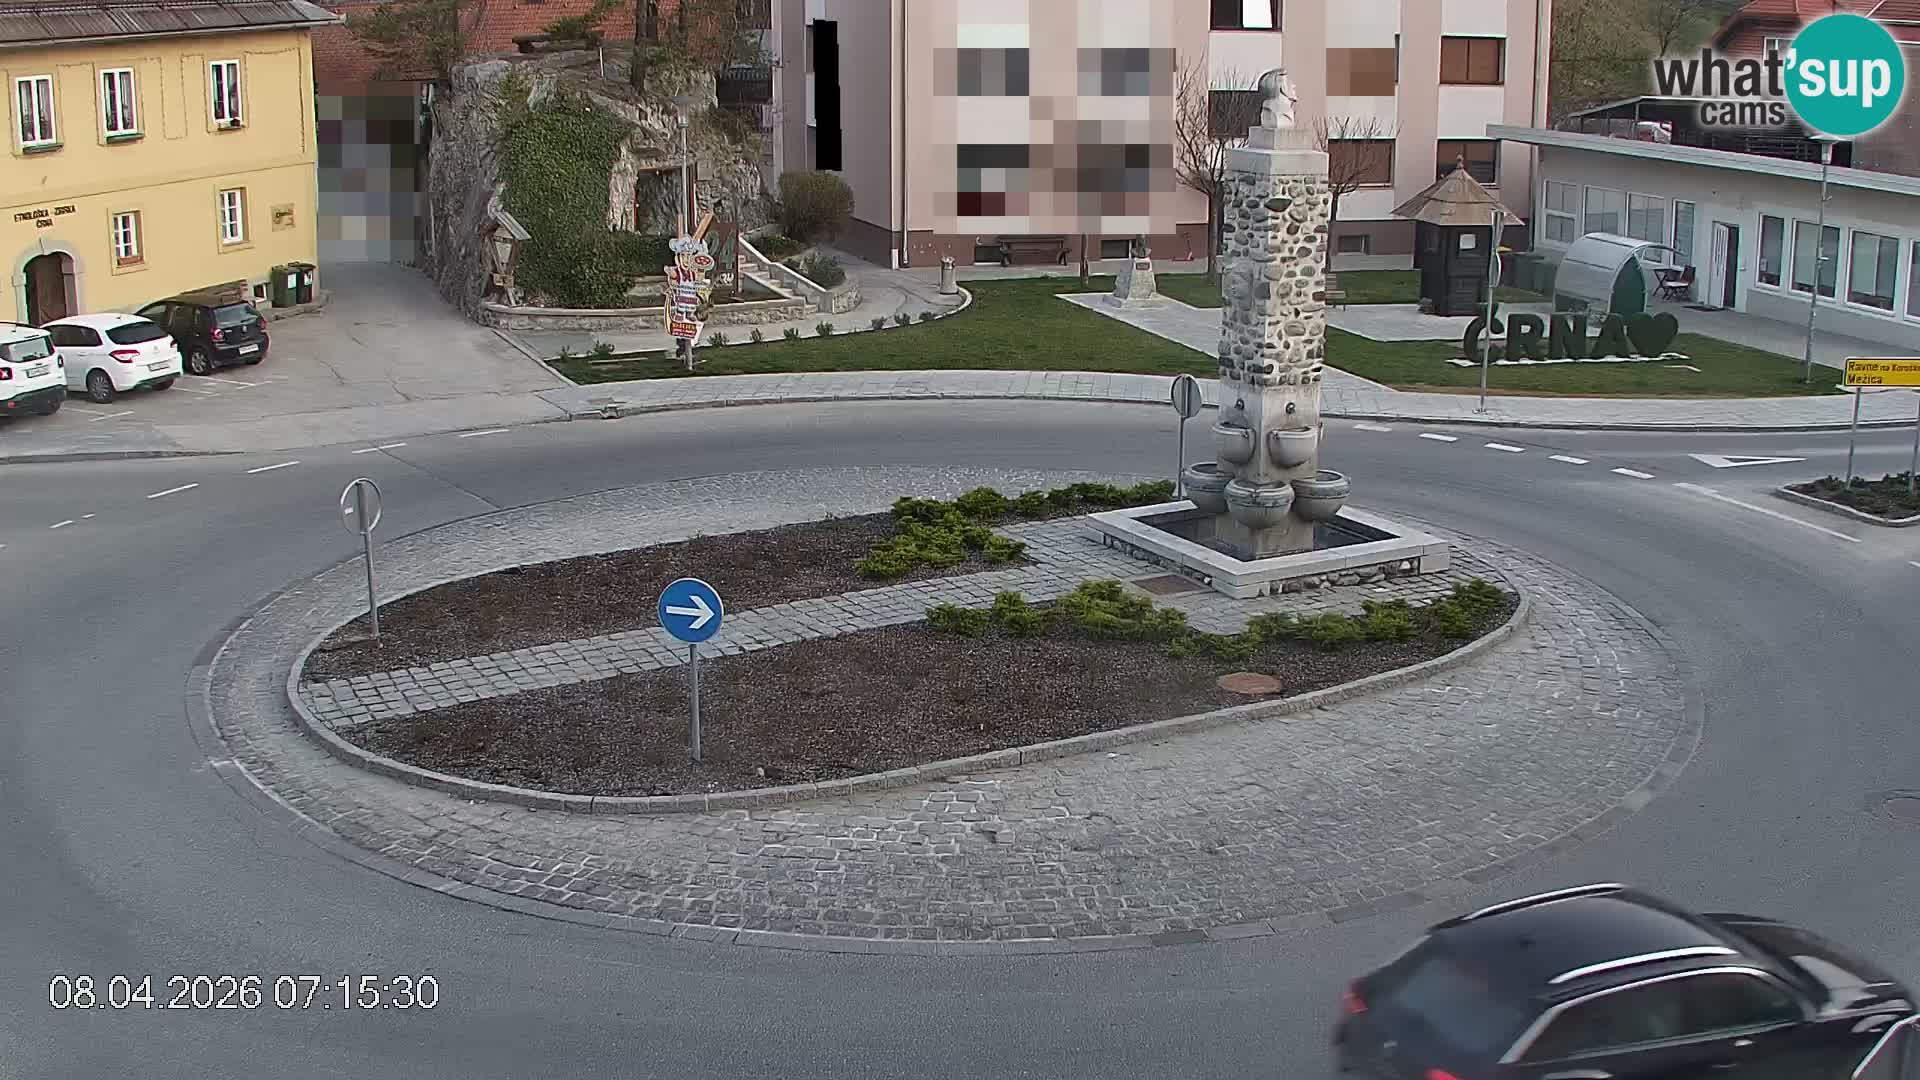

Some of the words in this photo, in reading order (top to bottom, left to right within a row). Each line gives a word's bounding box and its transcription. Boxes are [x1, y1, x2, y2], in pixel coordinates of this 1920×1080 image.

[1463, 302, 1632, 363] ČRNA
[1848, 361, 1879, 371] Ravne
[1848, 373, 1882, 384] Mežica
